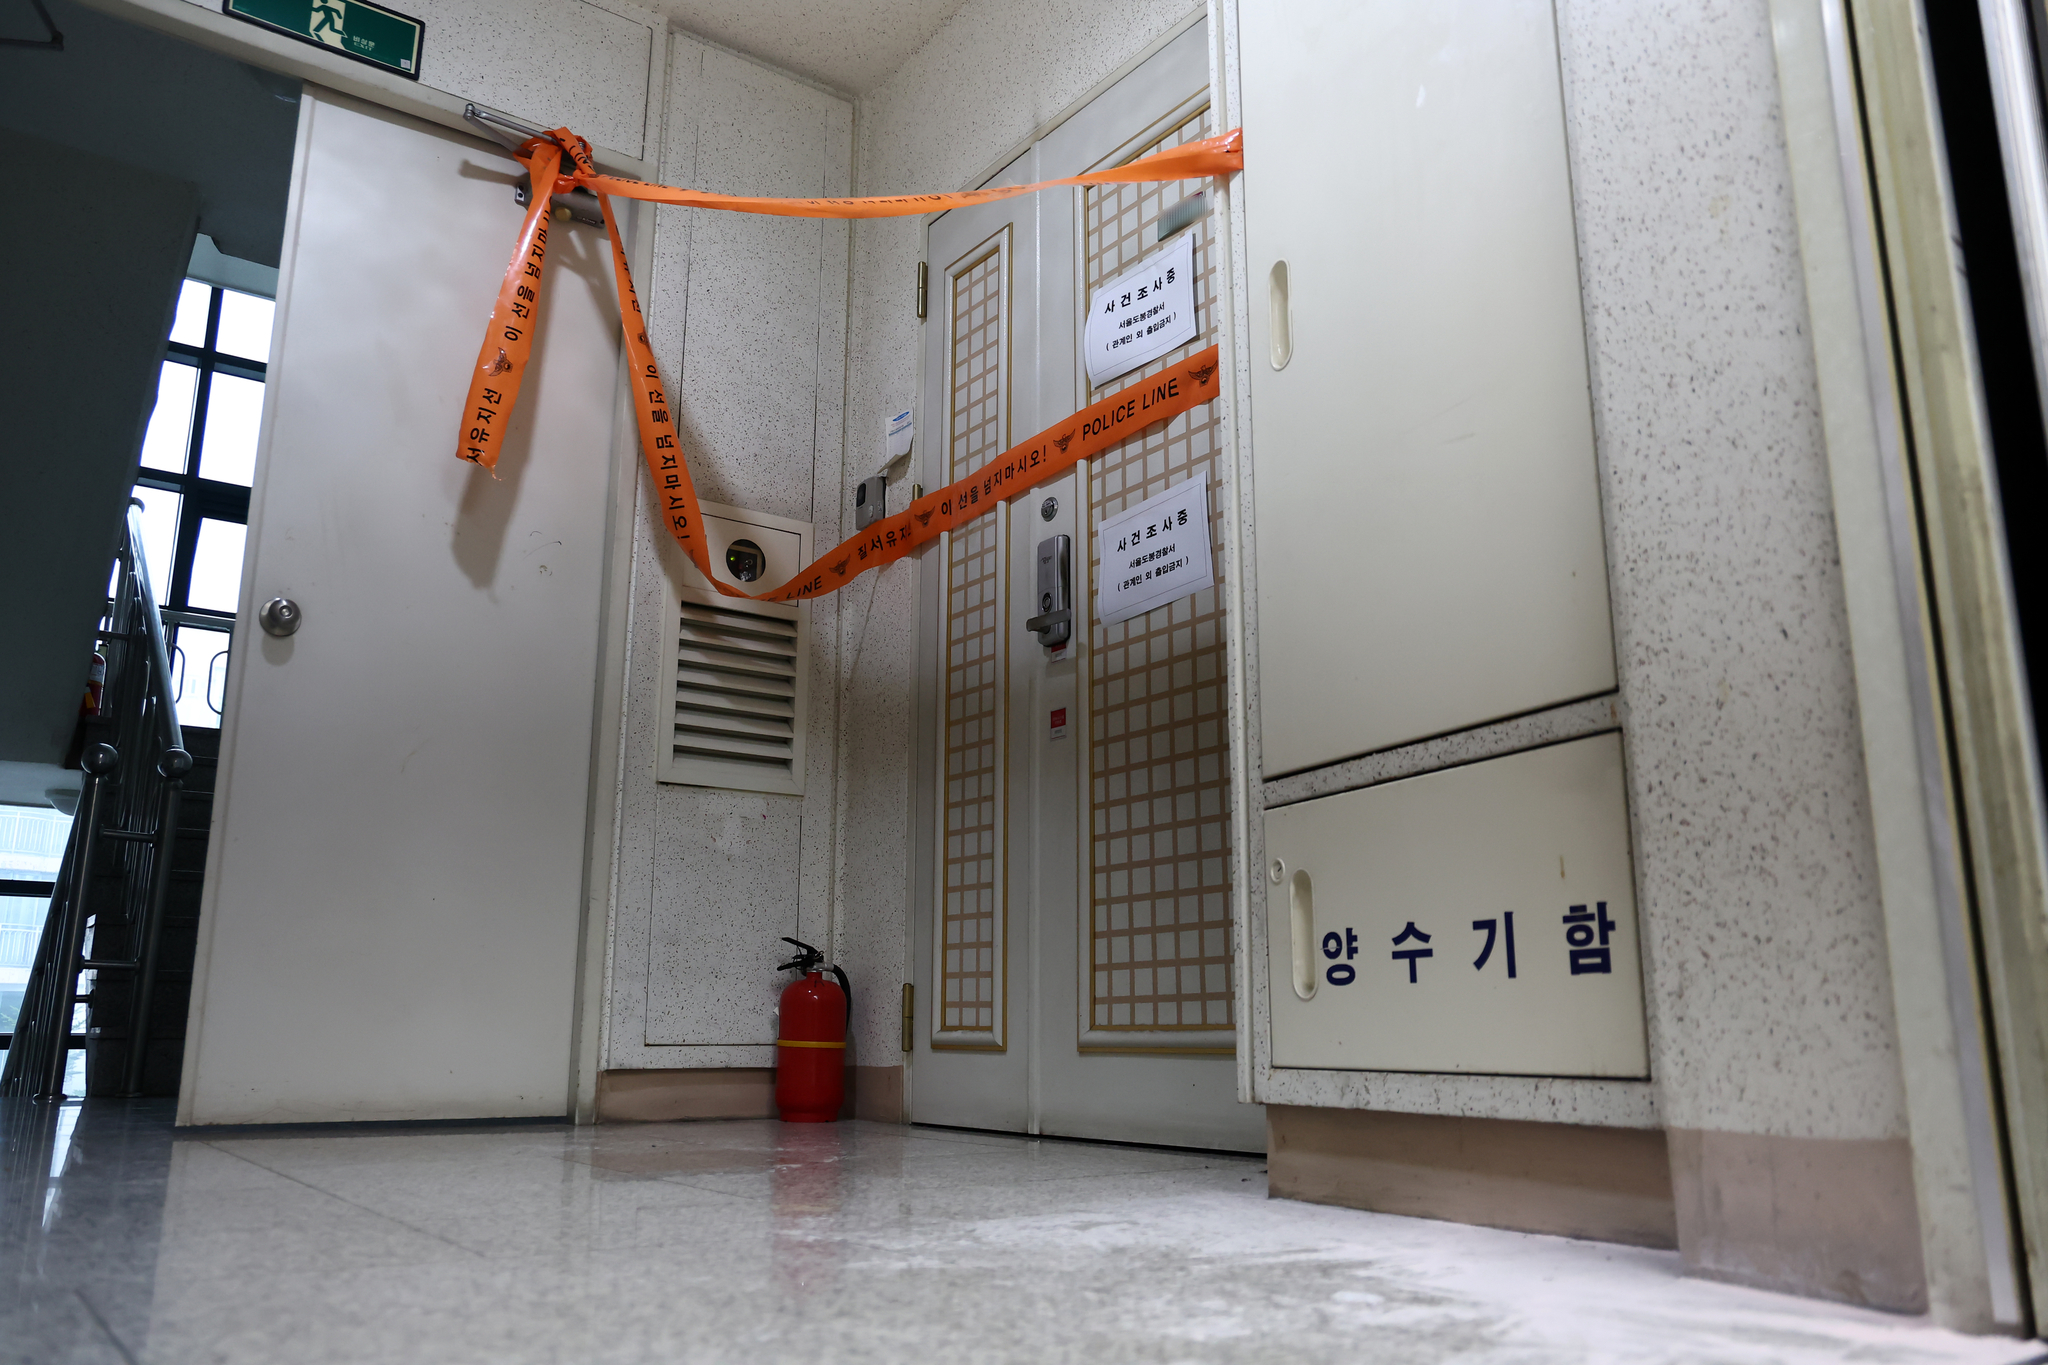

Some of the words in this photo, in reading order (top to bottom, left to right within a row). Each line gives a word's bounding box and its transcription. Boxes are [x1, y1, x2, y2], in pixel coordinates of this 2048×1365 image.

[353, 42, 373, 52] EXIT
[511, 285, 536, 319] 선을
[1118, 302, 1166, 330] 서울도봉경찰서
[504, 325, 523, 341] 이
[1136, 330, 1144, 339] 외
[646, 364, 660, 379] 이
[649, 389, 669, 424] 선을
[1082, 399, 1136, 441] POLICE
[1142, 377, 1179, 410] LINE
[655, 434, 691, 540] 넘지마시오!
[941, 499, 952, 515] 이
[958, 485, 979, 510] 선을
[983, 444, 1047, 496] 넘지마시오!
[1128, 543, 1176, 569] 서울도봉경찰서
[1145, 571, 1152, 580] 외
